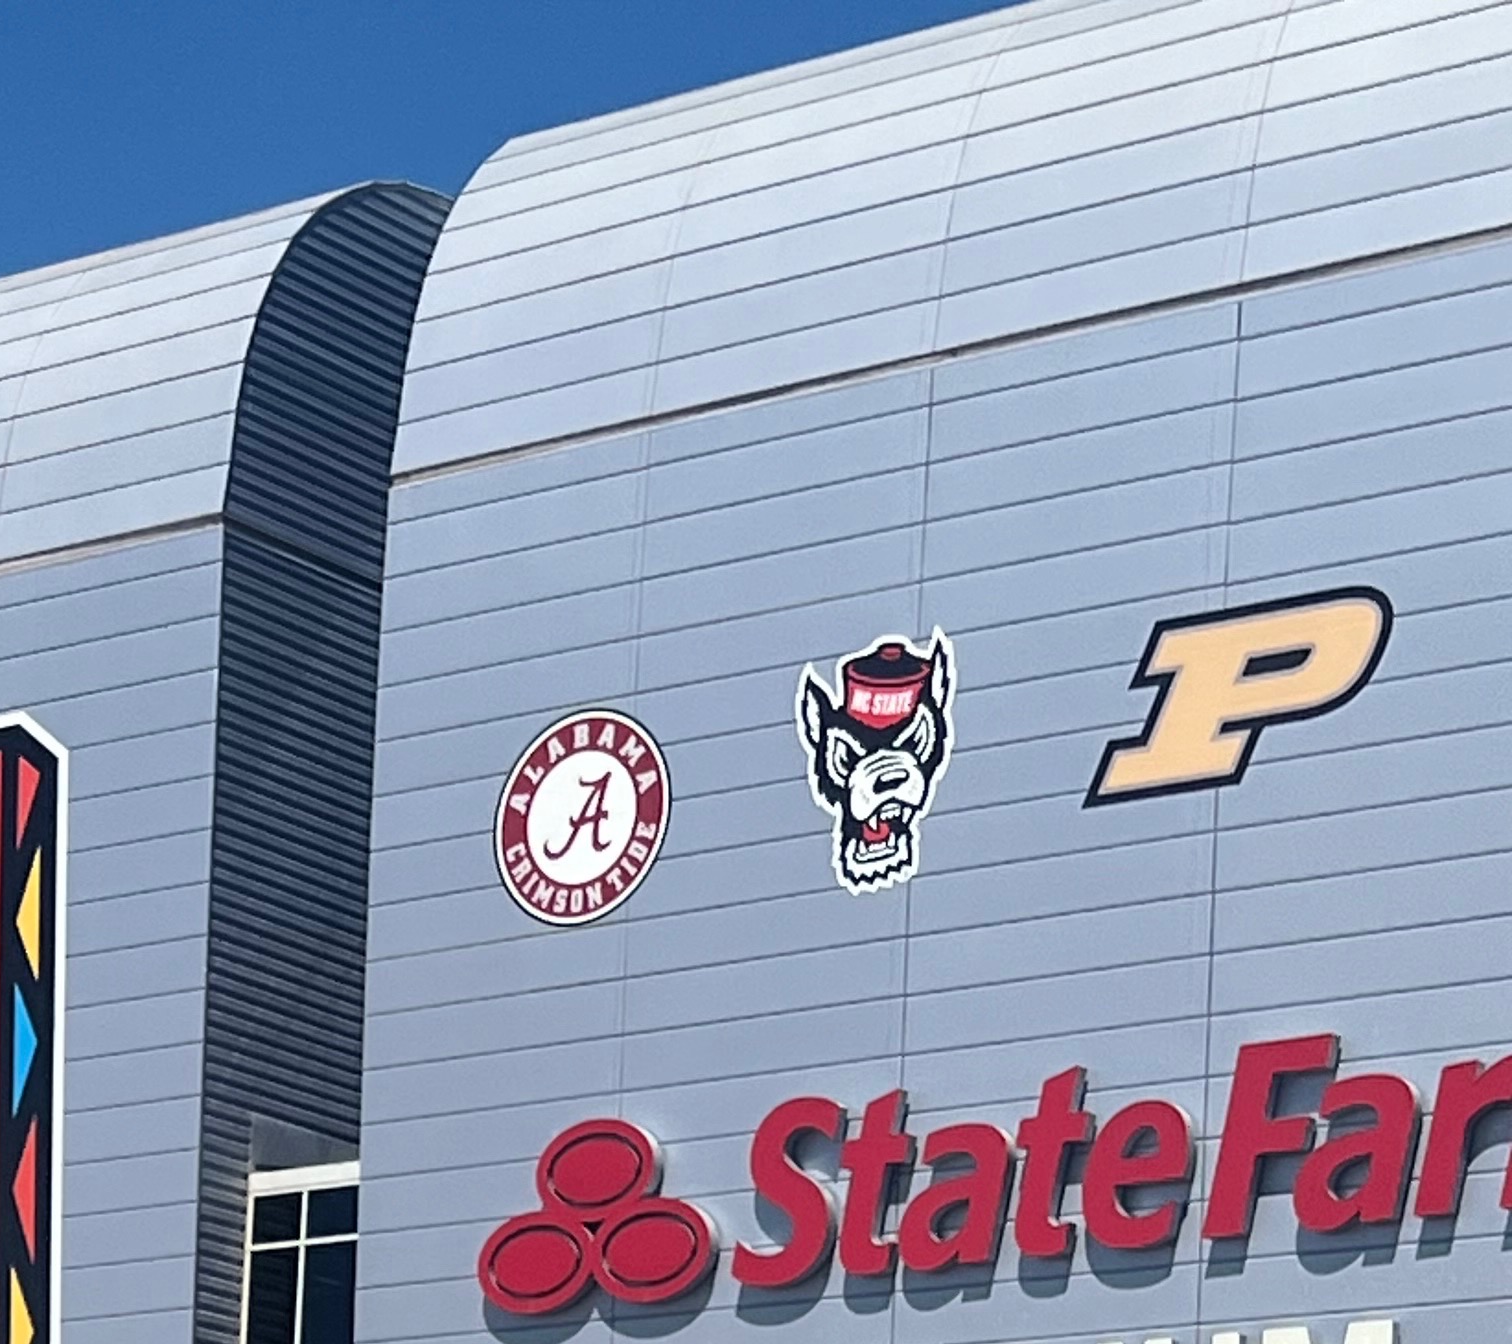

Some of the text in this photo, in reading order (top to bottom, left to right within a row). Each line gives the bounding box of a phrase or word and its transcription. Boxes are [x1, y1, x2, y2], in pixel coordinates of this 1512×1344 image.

[872, 690, 913, 715] STATE
[1085, 587, 1394, 807] P
[509, 723, 658, 816] ALABAMA
[543, 771, 612, 860] A
[506, 821, 657, 913] CRIMSON TIDE
